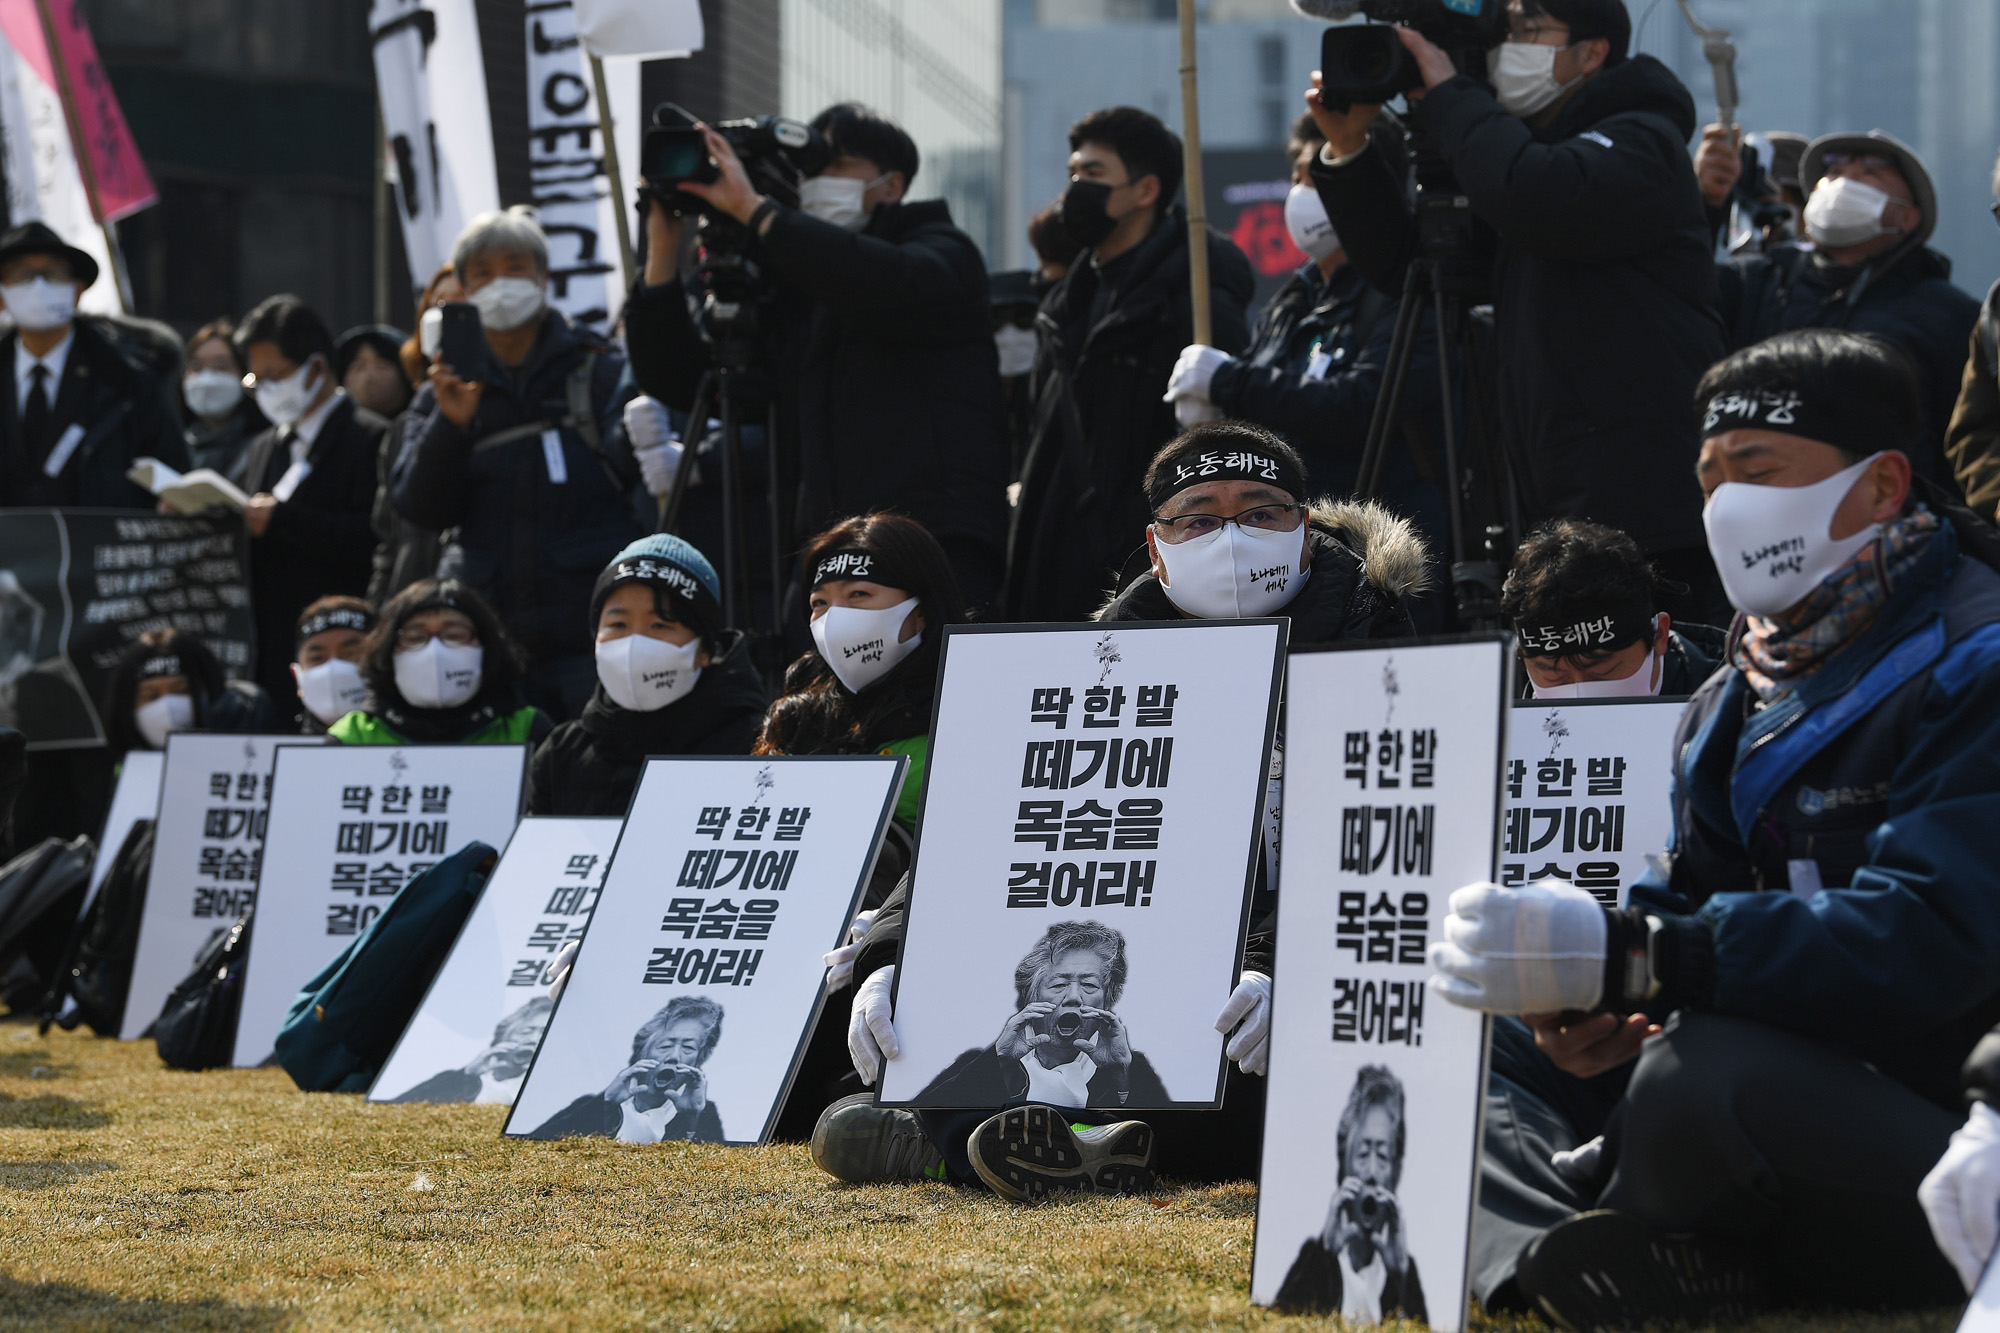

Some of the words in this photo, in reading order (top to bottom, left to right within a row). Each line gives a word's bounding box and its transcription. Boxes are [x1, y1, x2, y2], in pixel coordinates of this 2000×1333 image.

[1174, 450, 1279, 485] 노동해방
[613, 560, 698, 600] 노동해방
[1250, 564, 1289, 583] 노나메기
[1265, 579, 1288, 593] 세상
[843, 639, 884, 659] 노나메기
[1521, 616, 1615, 651] 노동해방
[861, 650, 884, 665] 세상
[1031, 687, 1074, 729] 딱
[1083, 685, 1126, 729] 한
[1136, 684, 1179, 728] 발
[1021, 737, 1174, 790] 떼기에
[1344, 730, 1370, 789] 딱
[1377, 728, 1403, 789] 한
[1411, 727, 1437, 788] 발
[1537, 758, 1577, 798] 한
[1587, 757, 1627, 796] 발
[210, 772, 232, 801] 딱
[235, 773, 258, 802] 한
[342, 786, 374, 814] 딱
[381, 785, 412, 814] 한
[421, 785, 452, 814] 발
[335, 821, 448, 855] 떼기에
[695, 806, 732, 841] 딱
[733, 806, 771, 841] 한
[773, 807, 811, 841] 발
[1014, 798, 1164, 852] 목숨을
[1340, 804, 1435, 876] 떼기에
[565, 854, 598, 879] 딱
[676, 849, 799, 891] 떼기에
[1006, 860, 1157, 909] 걸어라!
[192, 887, 256, 919] 걸어
[660, 898, 779, 941] 목숨을
[1336, 891, 1429, 965] 목숨을
[642, 947, 764, 986] 걸어라!
[1332, 978, 1425, 1047] 걸어라!
